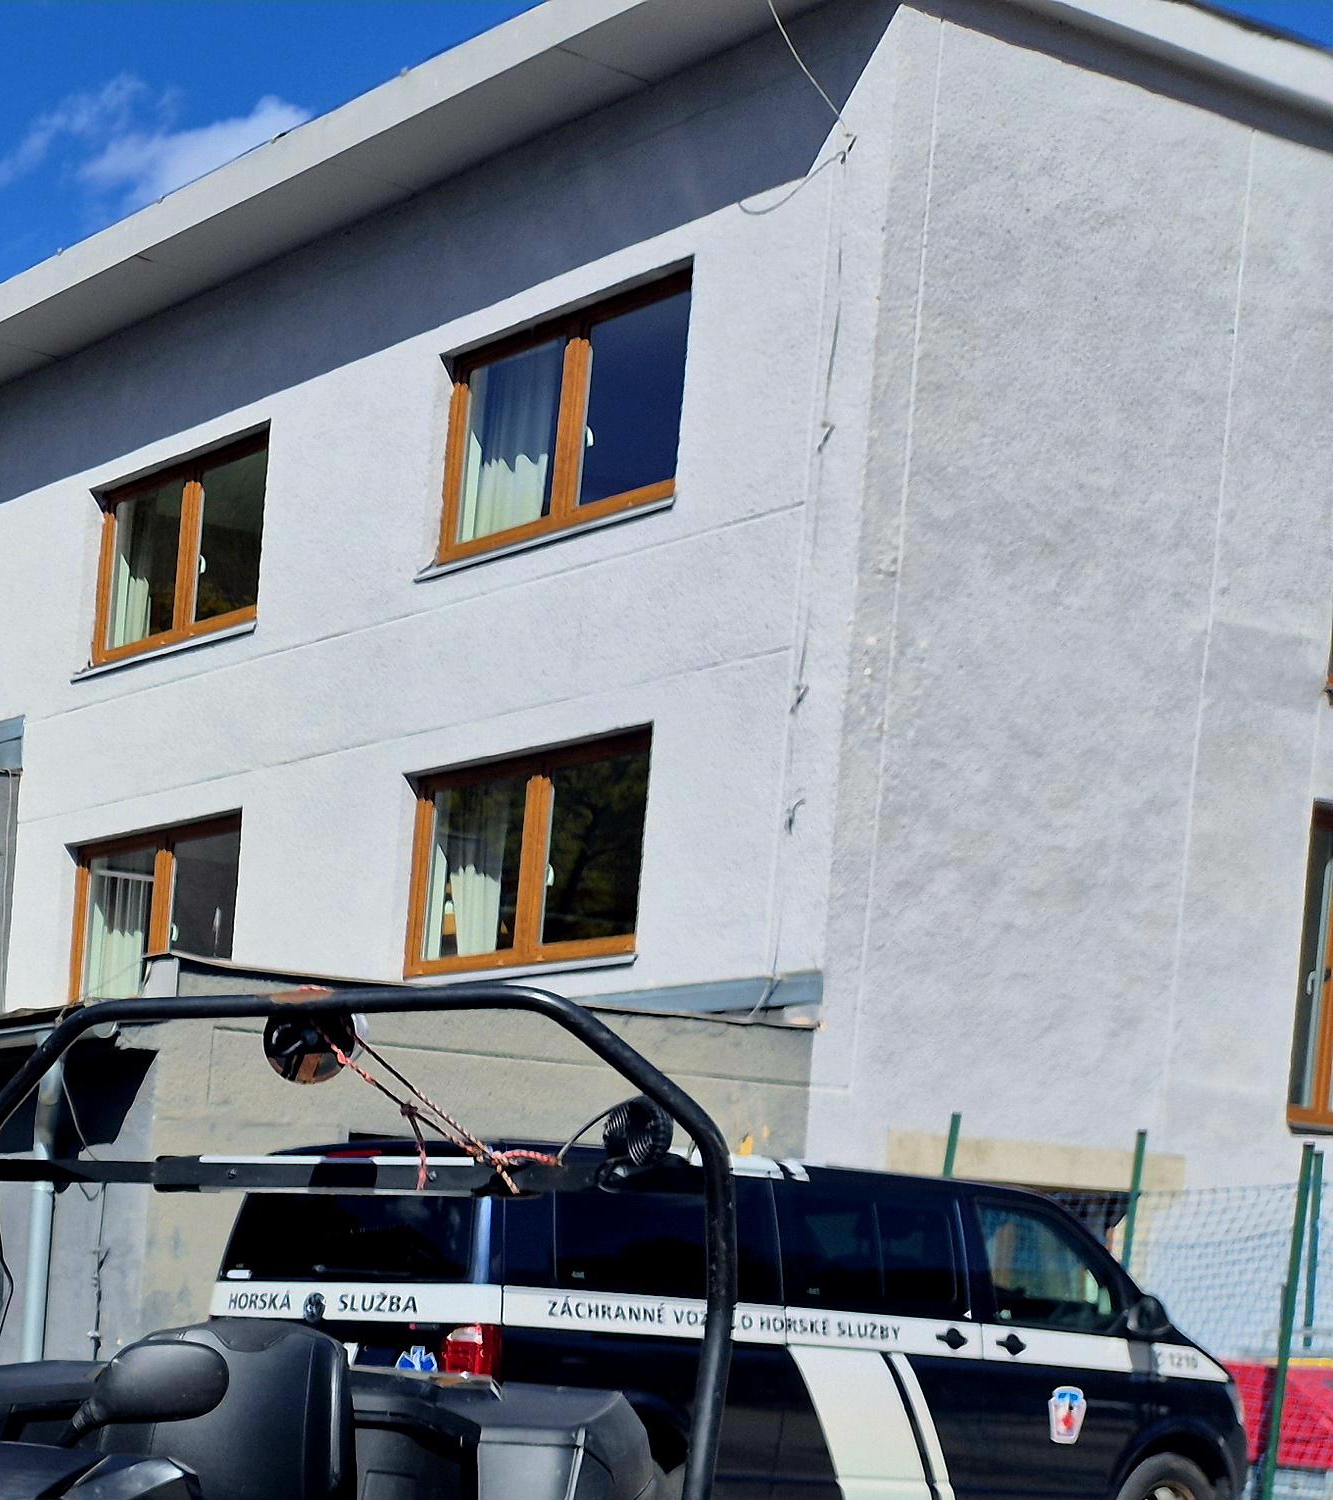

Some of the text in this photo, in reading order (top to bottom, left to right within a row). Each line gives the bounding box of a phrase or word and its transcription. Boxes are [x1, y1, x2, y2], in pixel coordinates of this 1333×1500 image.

[228, 1290, 418, 1313] HORSKÁ SLUŽBA
[547, 1296, 665, 1324] ZÁCHRANNÉ
